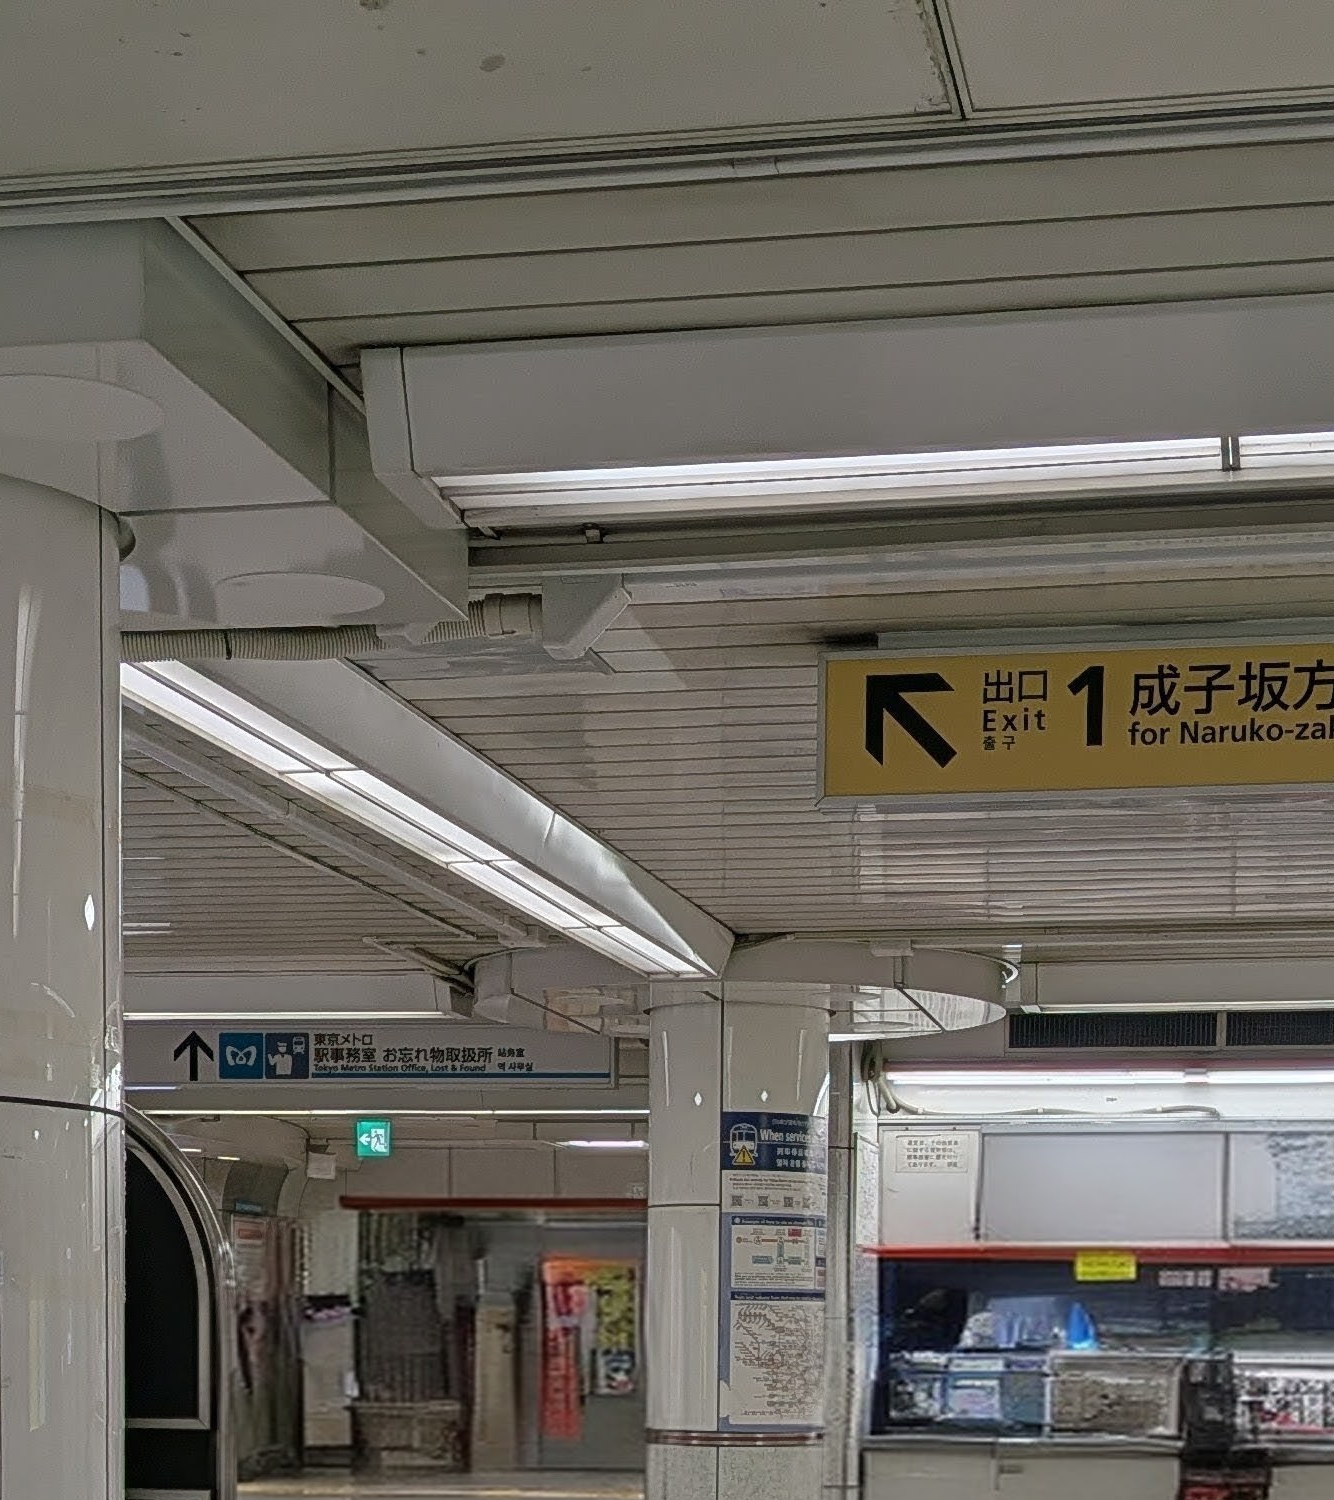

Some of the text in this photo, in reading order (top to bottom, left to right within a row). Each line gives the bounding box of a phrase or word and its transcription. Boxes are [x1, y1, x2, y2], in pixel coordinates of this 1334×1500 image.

[982, 669, 1048, 704] 出口
[1067, 665, 1105, 747] 1
[982, 708, 1047, 732] Exit
[1128, 720, 1171, 746] for
[314, 1033, 373, 1047] 東京メトロ
[314, 1047, 493, 1063] 駅事務室 お忘れ物取扱所
[314, 1063, 338, 1073] Tokyo
[341, 1063, 366, 1072] Metro
[368, 1063, 399, 1072] Station
[431, 1063, 449, 1072] Lost
[450, 1063, 458, 1072] &
[460, 1063, 486, 1072] Found
[760, 1128, 784, 1141] When
